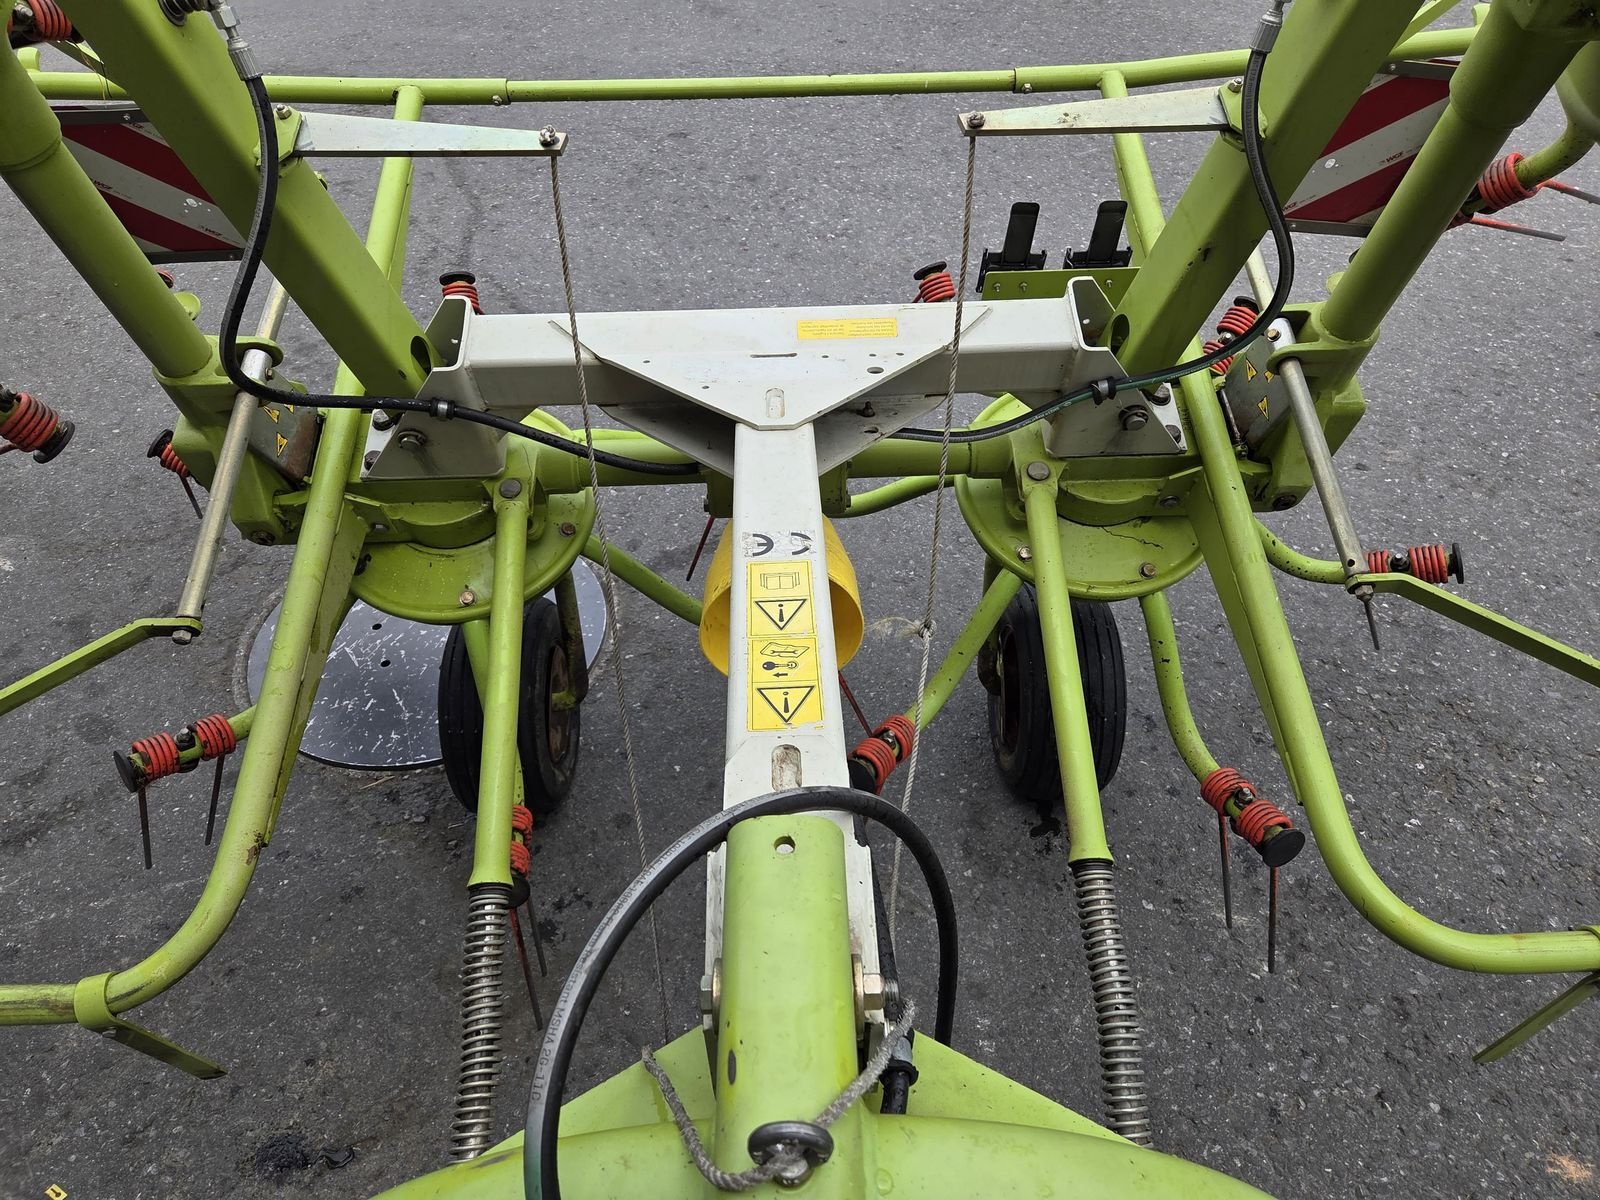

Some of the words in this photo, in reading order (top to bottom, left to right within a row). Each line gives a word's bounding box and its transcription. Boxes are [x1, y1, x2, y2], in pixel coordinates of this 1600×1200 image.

[559, 947, 592, 1004] Resistant
[543, 1005, 565, 1046] MSHA
[530, 1046, 552, 1101] 2G-11C
